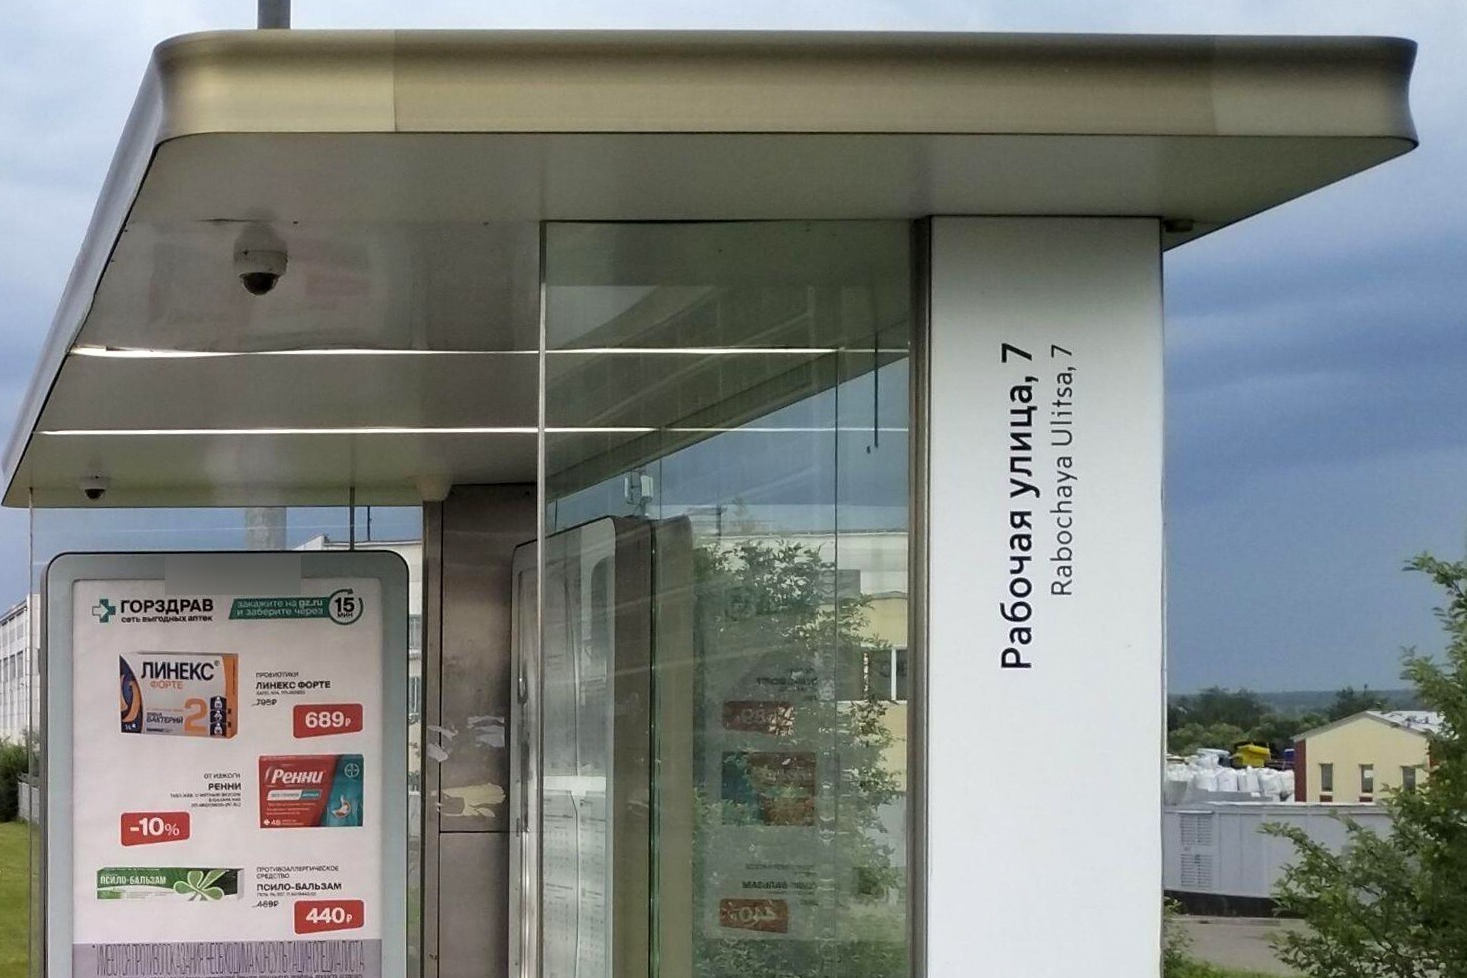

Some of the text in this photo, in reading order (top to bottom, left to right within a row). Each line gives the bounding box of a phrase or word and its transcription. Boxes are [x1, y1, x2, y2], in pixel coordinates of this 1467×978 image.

[1050, 344, 1077, 596] Rabochaya Ulitsa, 7
[999, 343, 1040, 669] Рабочая улица, 7
[120, 599, 214, 615] ГОРЗДРАВ
[335, 597, 355, 613] 15
[141, 661, 215, 681] ЛИНЕКС
[150, 680, 184, 690] ФОРТЕ
[256, 681, 331, 690] ЛИНЕКС ФОРТЕ
[184, 698, 209, 734] 2
[271, 768, 324, 784] Ренни
[256, 882, 343, 891] ПСИЛО-БАЛЬЗАМ
